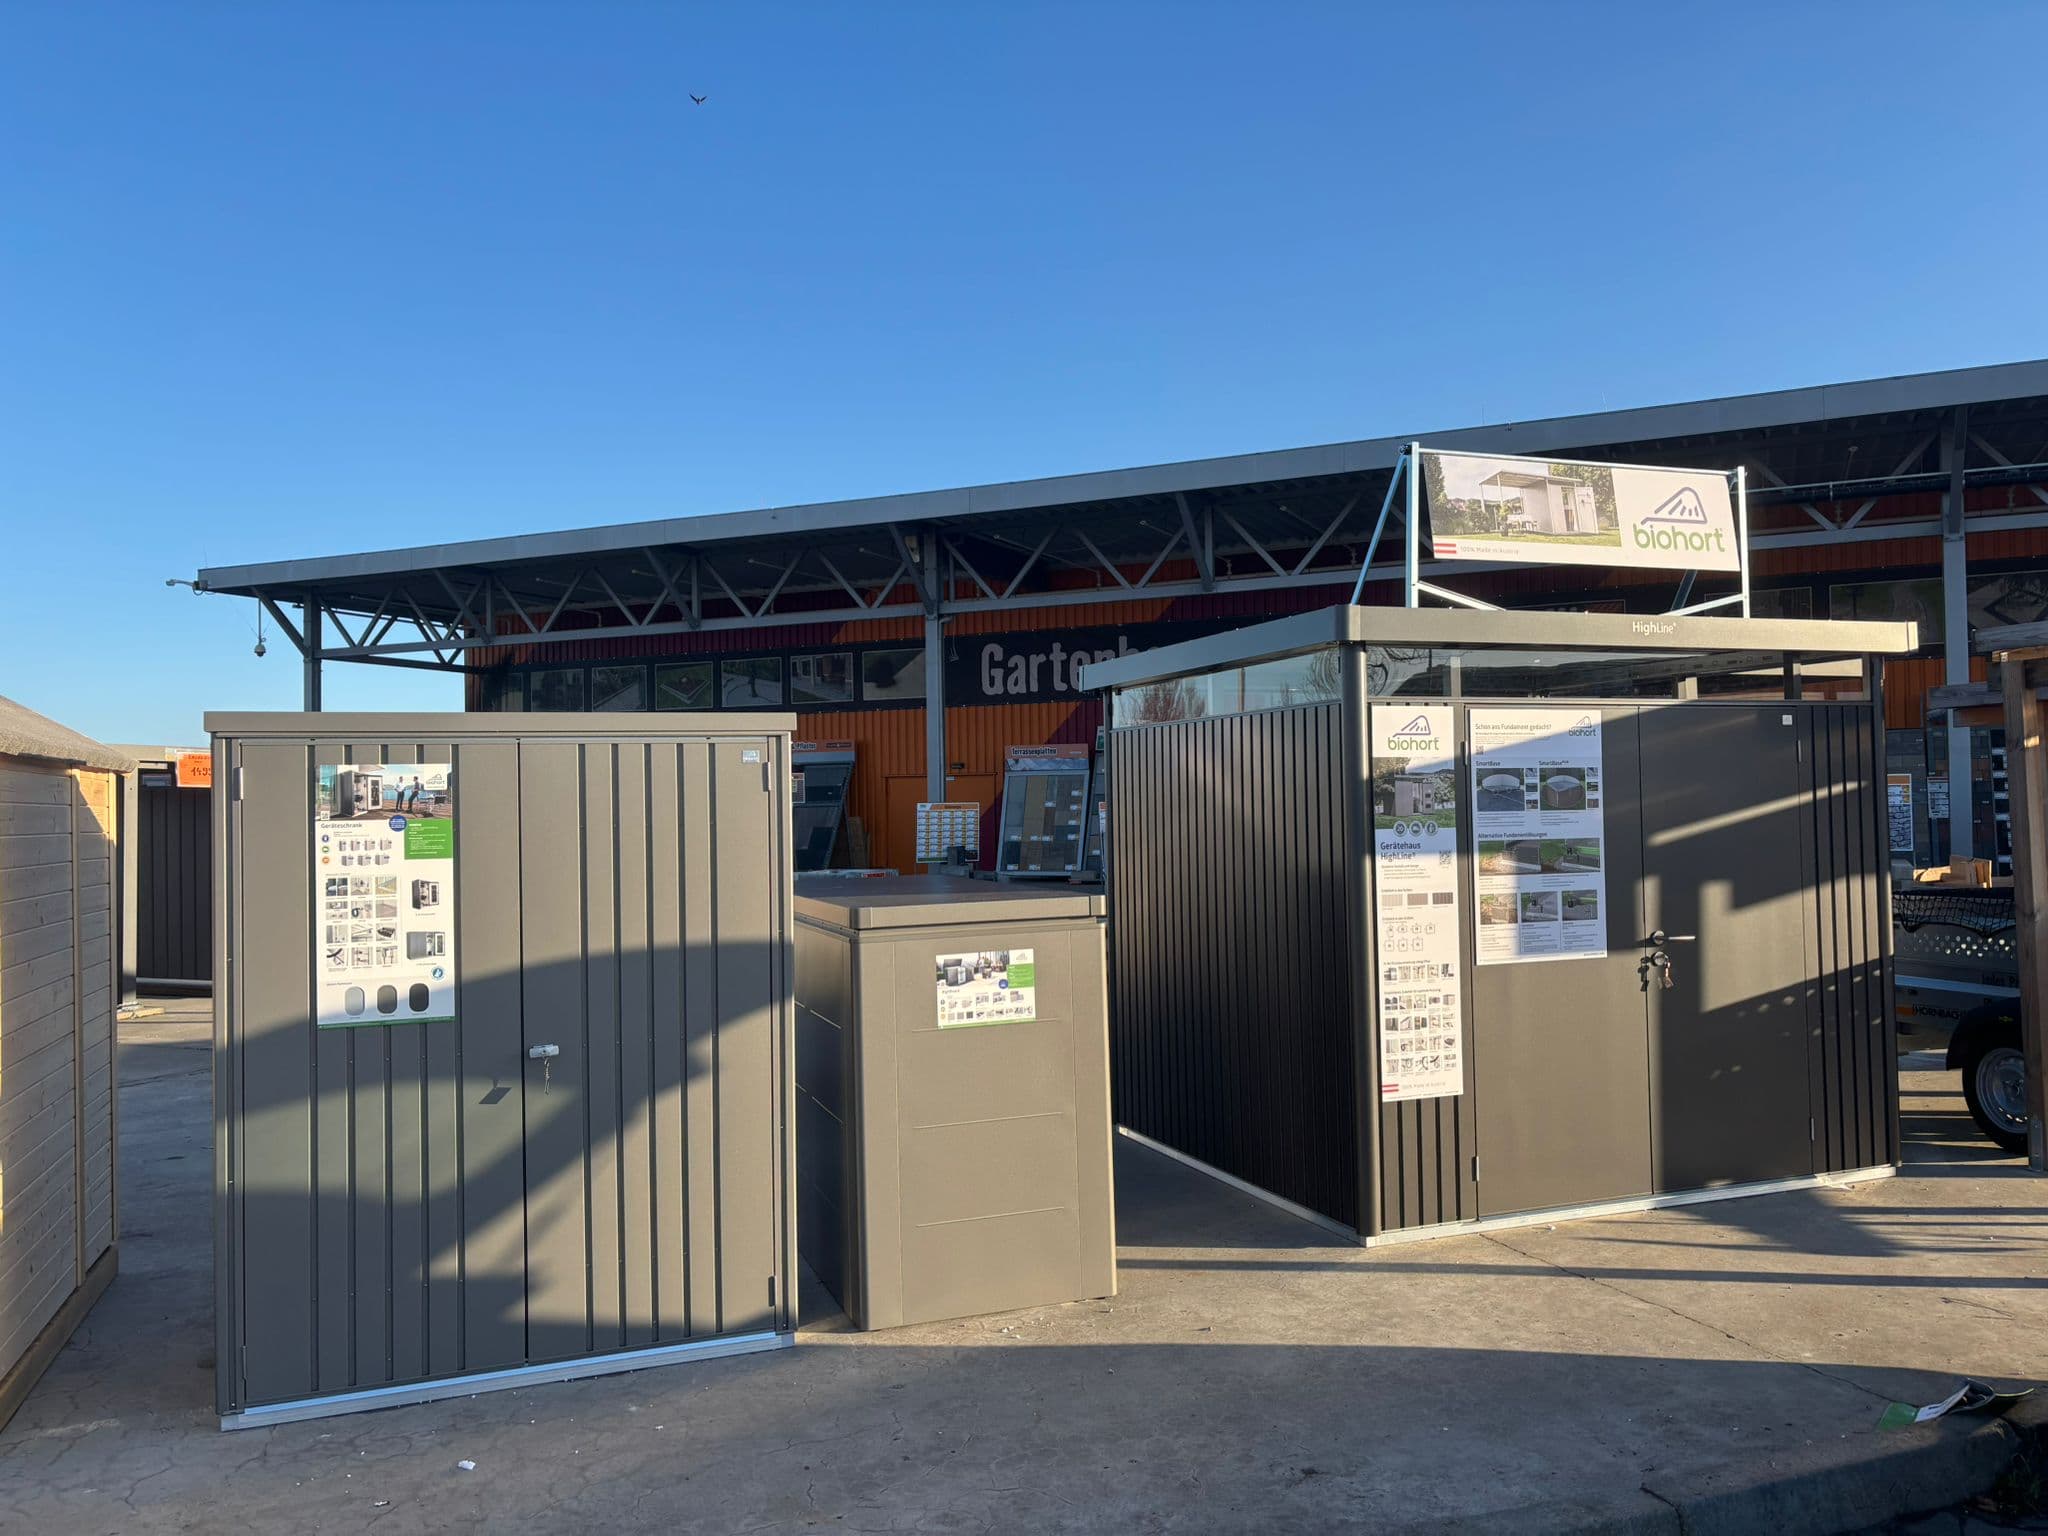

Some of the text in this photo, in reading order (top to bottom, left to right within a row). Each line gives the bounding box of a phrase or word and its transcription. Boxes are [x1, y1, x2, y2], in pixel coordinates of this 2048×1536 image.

[1633, 523, 1725, 552] biohort
[1568, 728, 1596, 737] biohort
[1388, 737, 1439, 751] biohort
[1380, 841, 1421, 850] Gerätehaus
